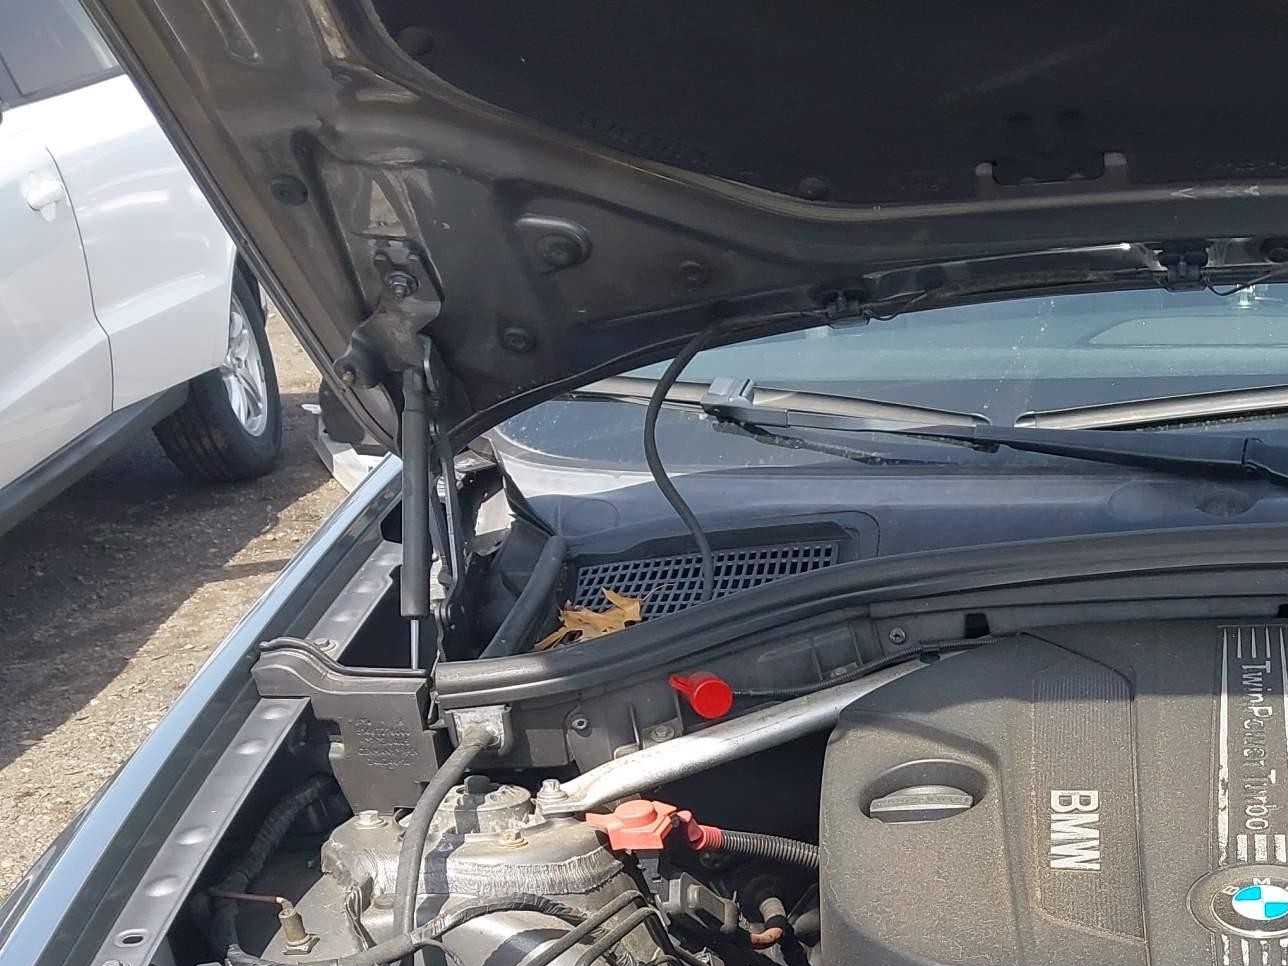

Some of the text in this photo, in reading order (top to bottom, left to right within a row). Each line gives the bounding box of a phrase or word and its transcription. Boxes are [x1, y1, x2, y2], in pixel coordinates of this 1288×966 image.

[1241, 660, 1277, 831] TwinPower Turbo
[1050, 789, 1100, 872] BMW
